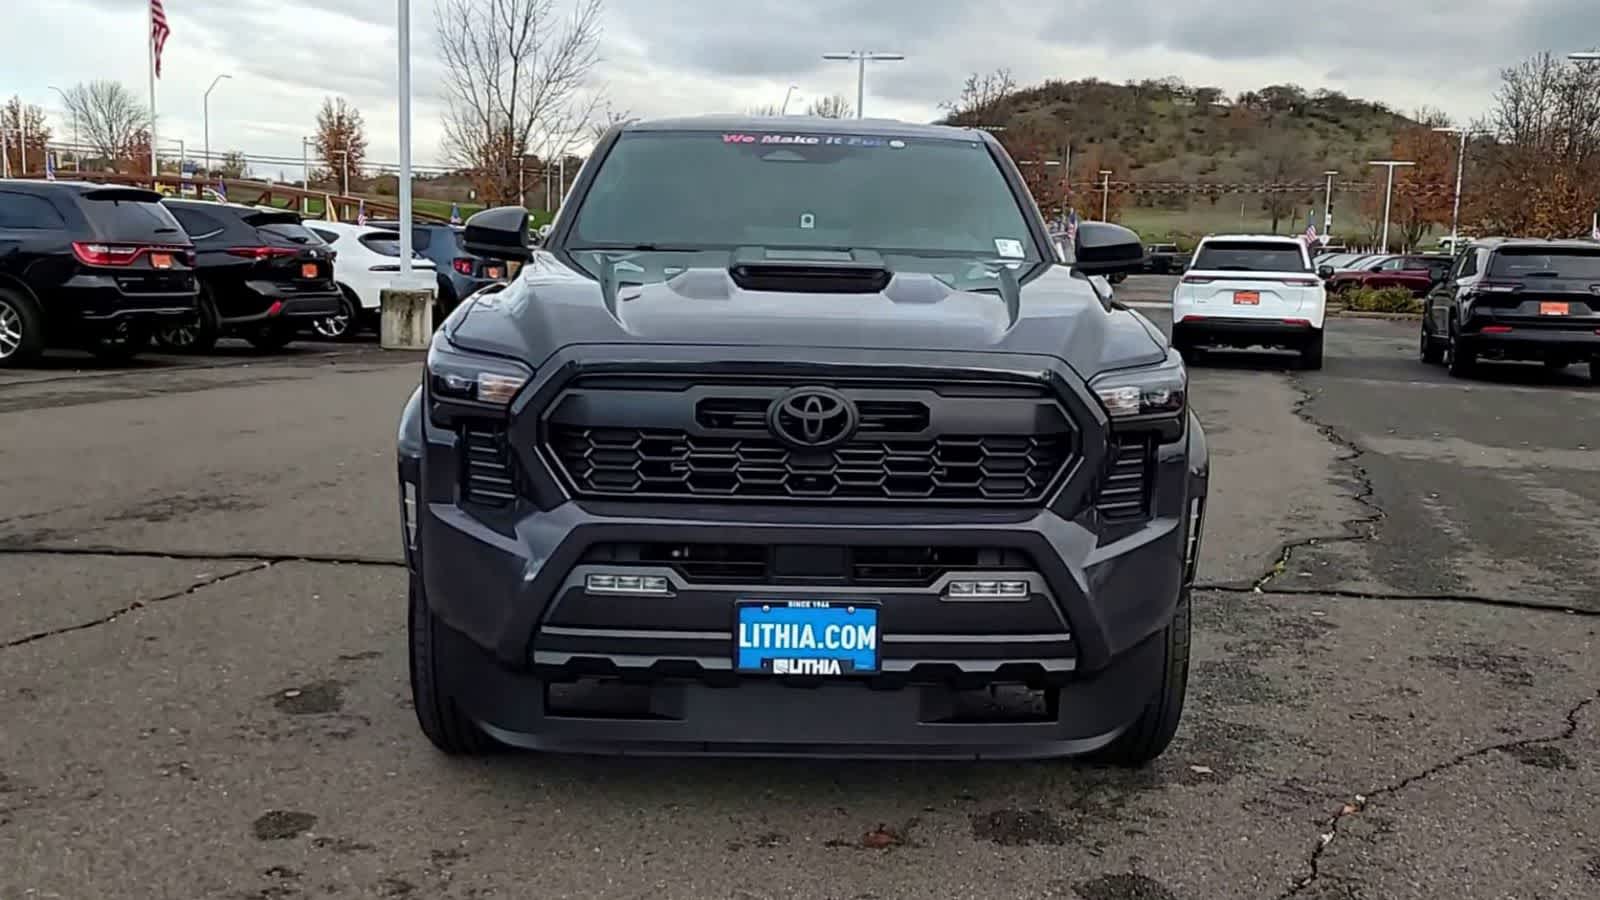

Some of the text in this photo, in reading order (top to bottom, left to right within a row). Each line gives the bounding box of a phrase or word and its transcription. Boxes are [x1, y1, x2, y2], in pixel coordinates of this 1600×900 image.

[722, 134, 755, 144] We
[761, 135, 819, 145] Make
[788, 600, 811, 608] SINCE
[739, 623, 876, 650] LITHIA.COM
[788, 659, 841, 675] LITHIA
